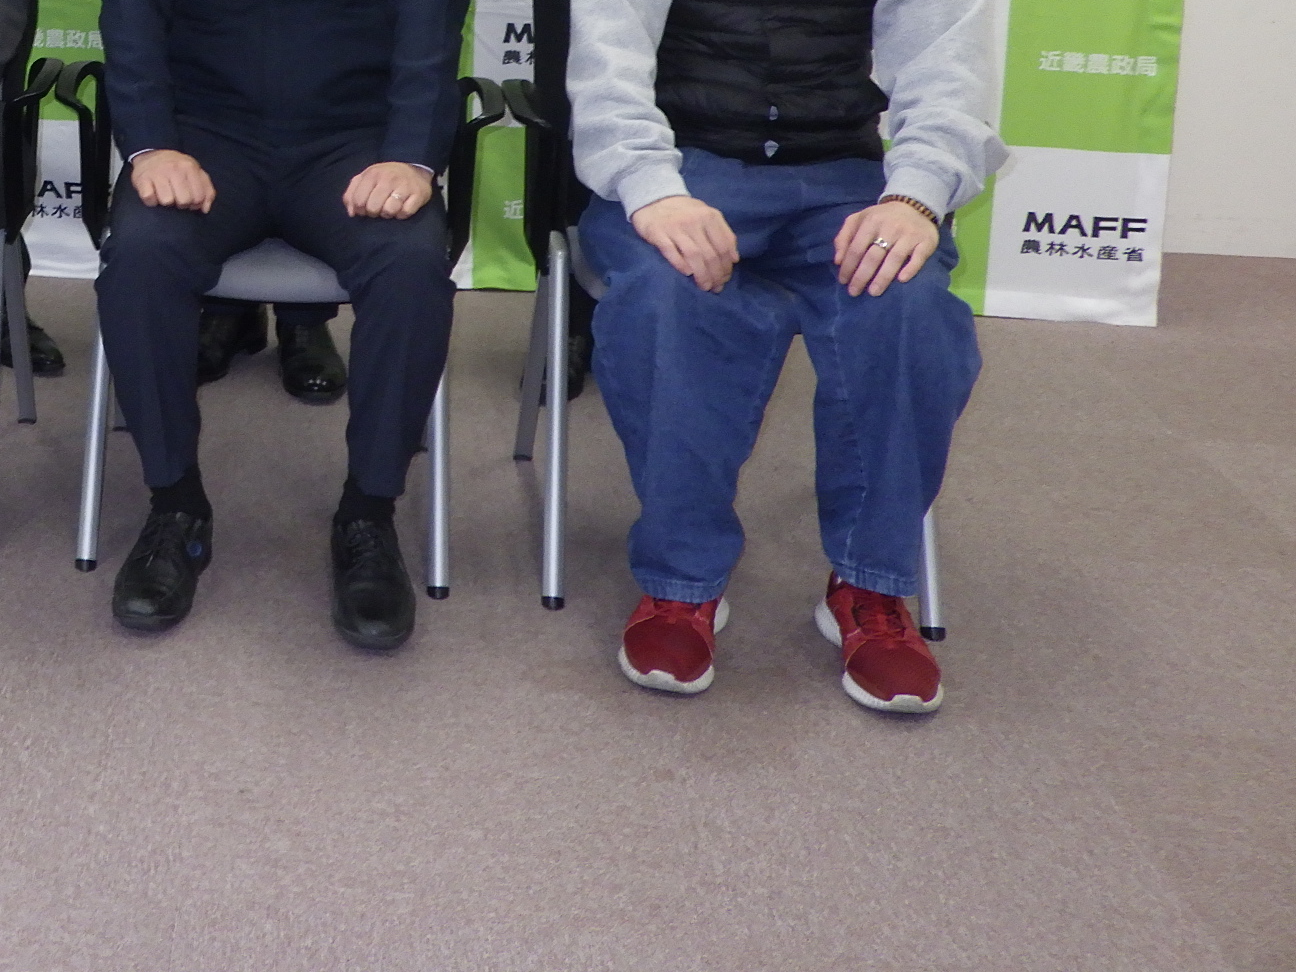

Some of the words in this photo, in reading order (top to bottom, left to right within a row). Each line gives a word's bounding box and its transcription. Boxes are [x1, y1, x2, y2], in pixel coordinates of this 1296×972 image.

[1039, 51, 1158, 76] 近畿農政局
[38, 180, 83, 199] AF
[1023, 212, 1147, 241] MAFF
[1021, 239, 1143, 261] 農林水産省
